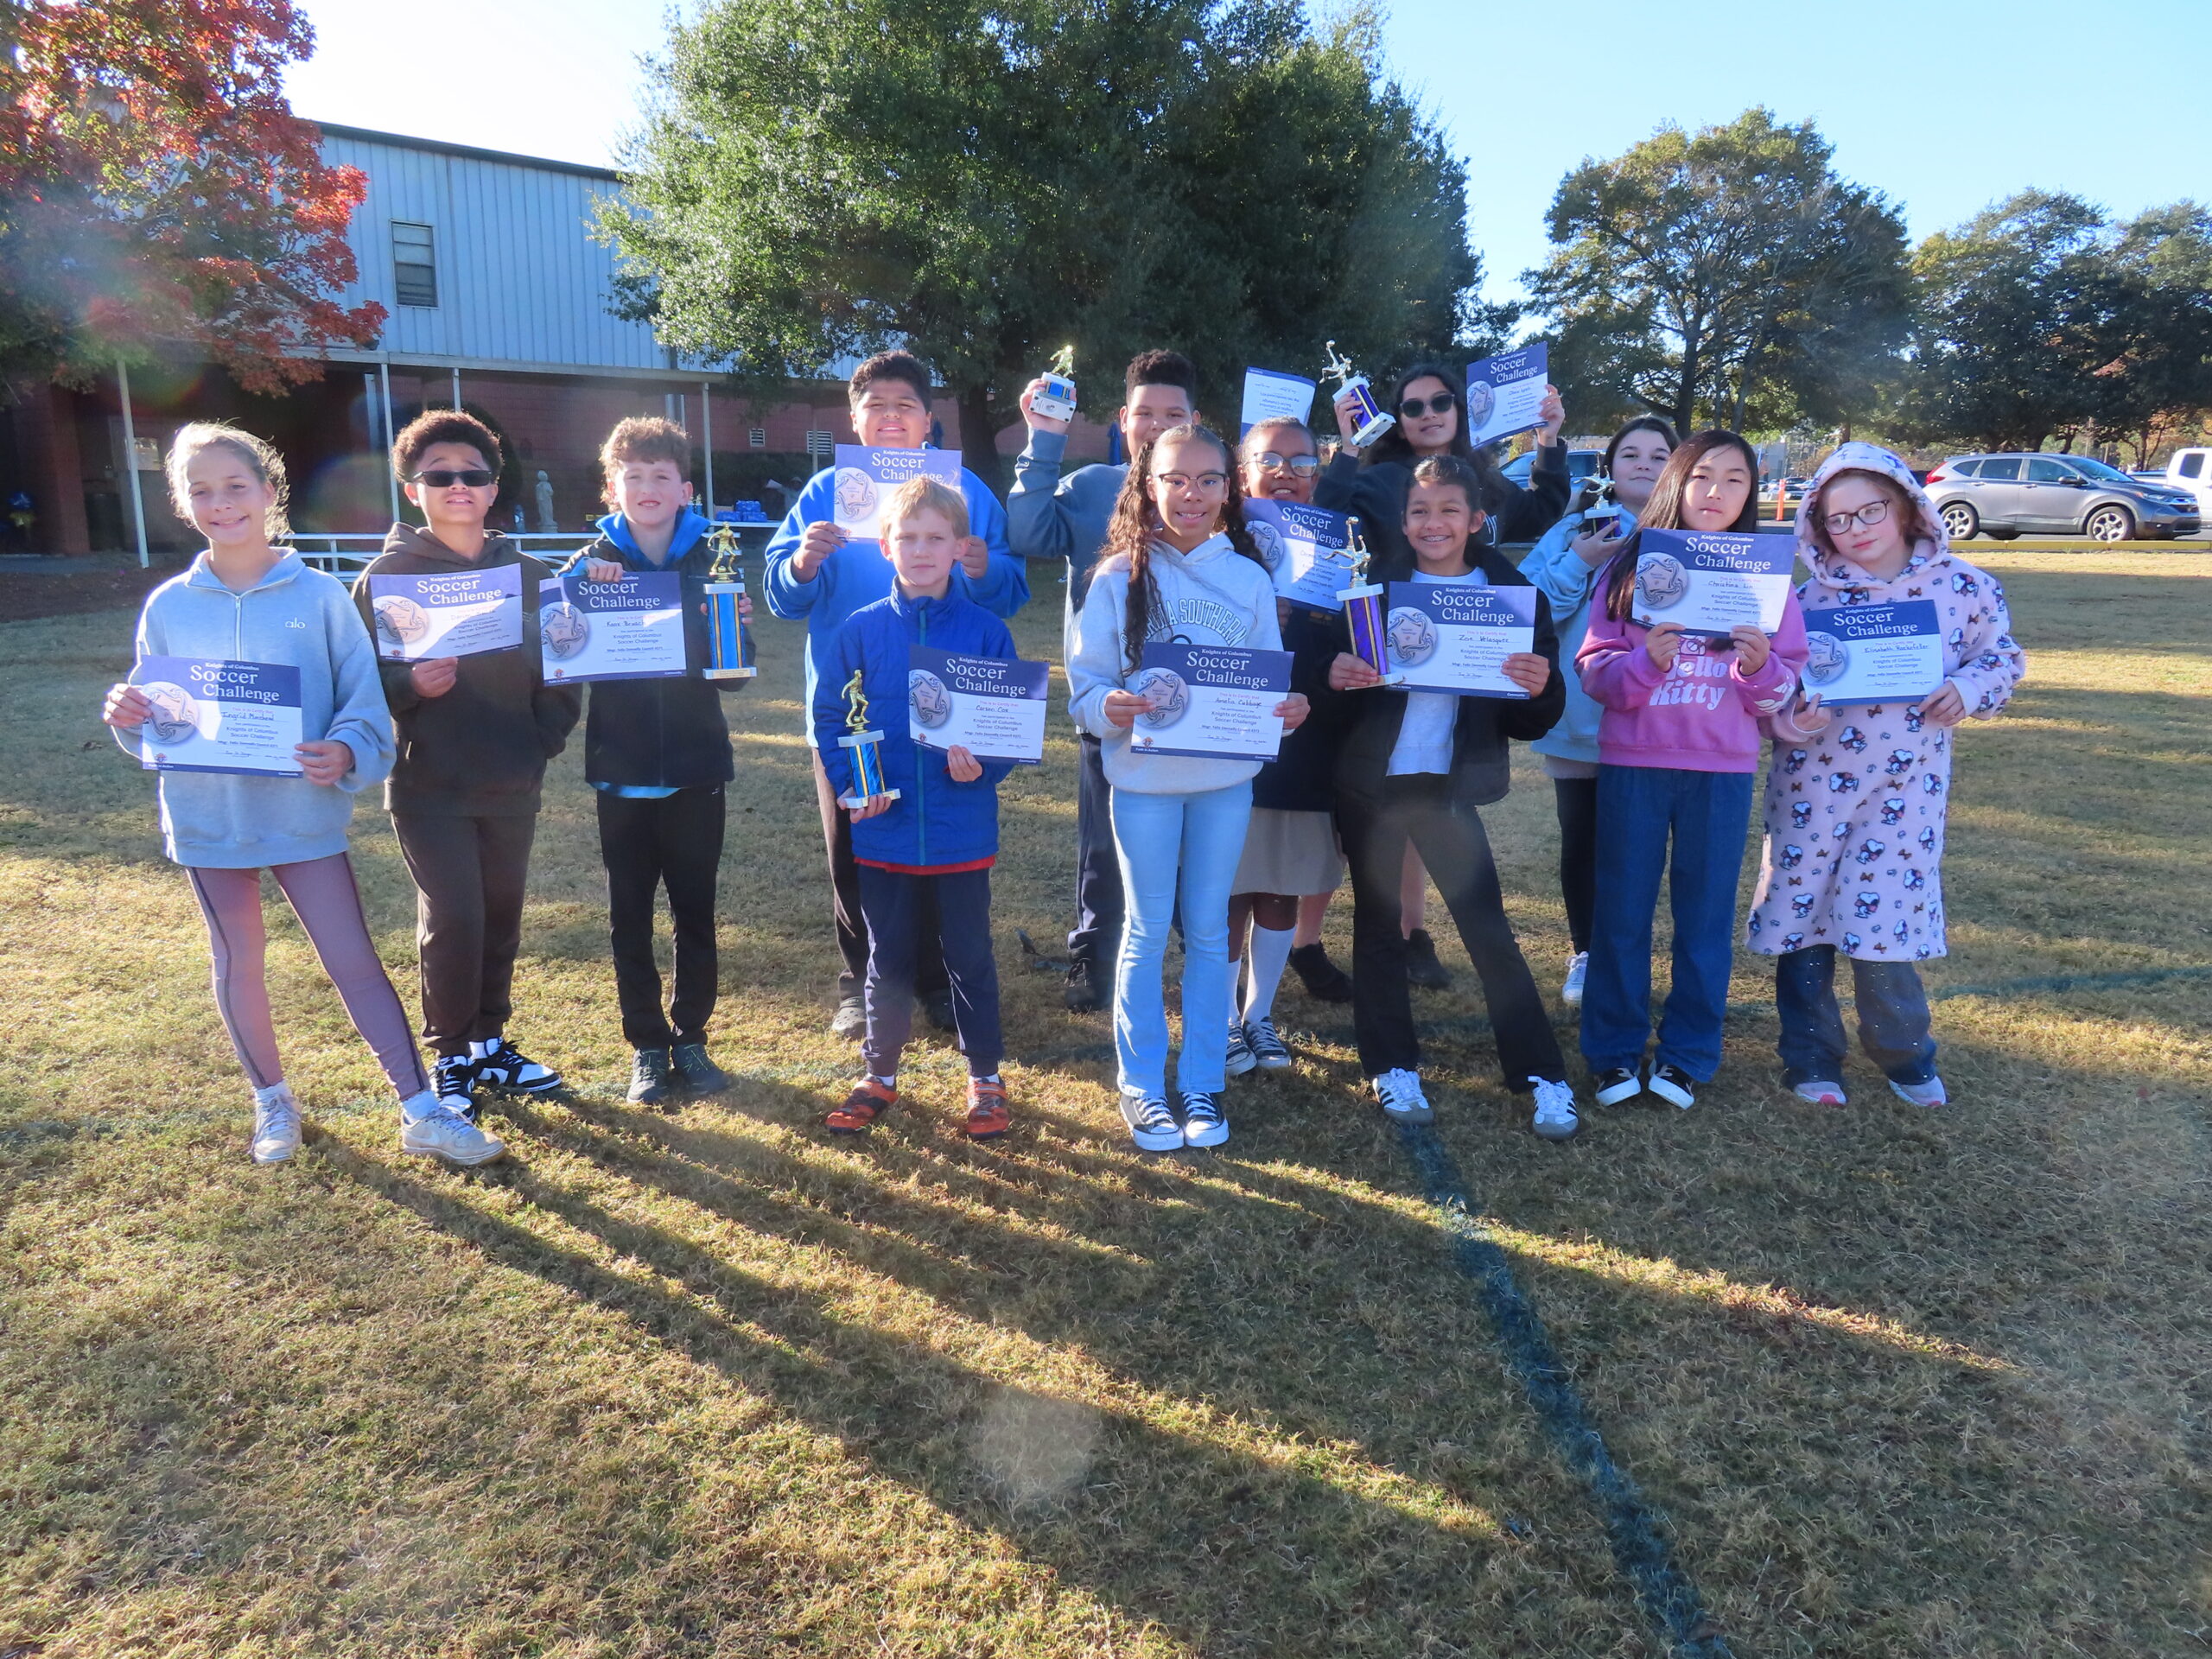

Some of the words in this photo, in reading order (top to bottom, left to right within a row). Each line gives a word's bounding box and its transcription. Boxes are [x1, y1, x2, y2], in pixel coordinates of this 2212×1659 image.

[1491, 357, 1527, 374] Soccer
[1497, 366, 1538, 383] Challenge
[872, 453, 925, 468] Soccer
[1281, 507, 1332, 530] Soccer
[1290, 524, 1343, 548] Challenge
[1685, 537, 1751, 555] Soccer
[1695, 554, 1771, 573] Challenge
[416, 580, 480, 594] Soccer
[578, 582, 638, 595] Soccer
[429, 589, 502, 604] Challenge
[589, 595, 660, 609] Challenge
[1432, 590, 1494, 607] Soccer
[285, 617, 306, 629] alo
[1179, 598, 1247, 648] SOUTHERN
[1442, 607, 1514, 626] Challenge
[1834, 613, 1894, 626] Soccer
[1847, 624, 1918, 636] Challenge
[946, 658, 1006, 679] Soccer
[1186, 651, 1249, 671] Soccer
[190, 665, 258, 684] Soccer
[1197, 669, 1268, 689] Challenge
[203, 683, 279, 703] Challenge
[956, 677, 1026, 697] Challenge
[1649, 680, 1726, 710] Kitty
